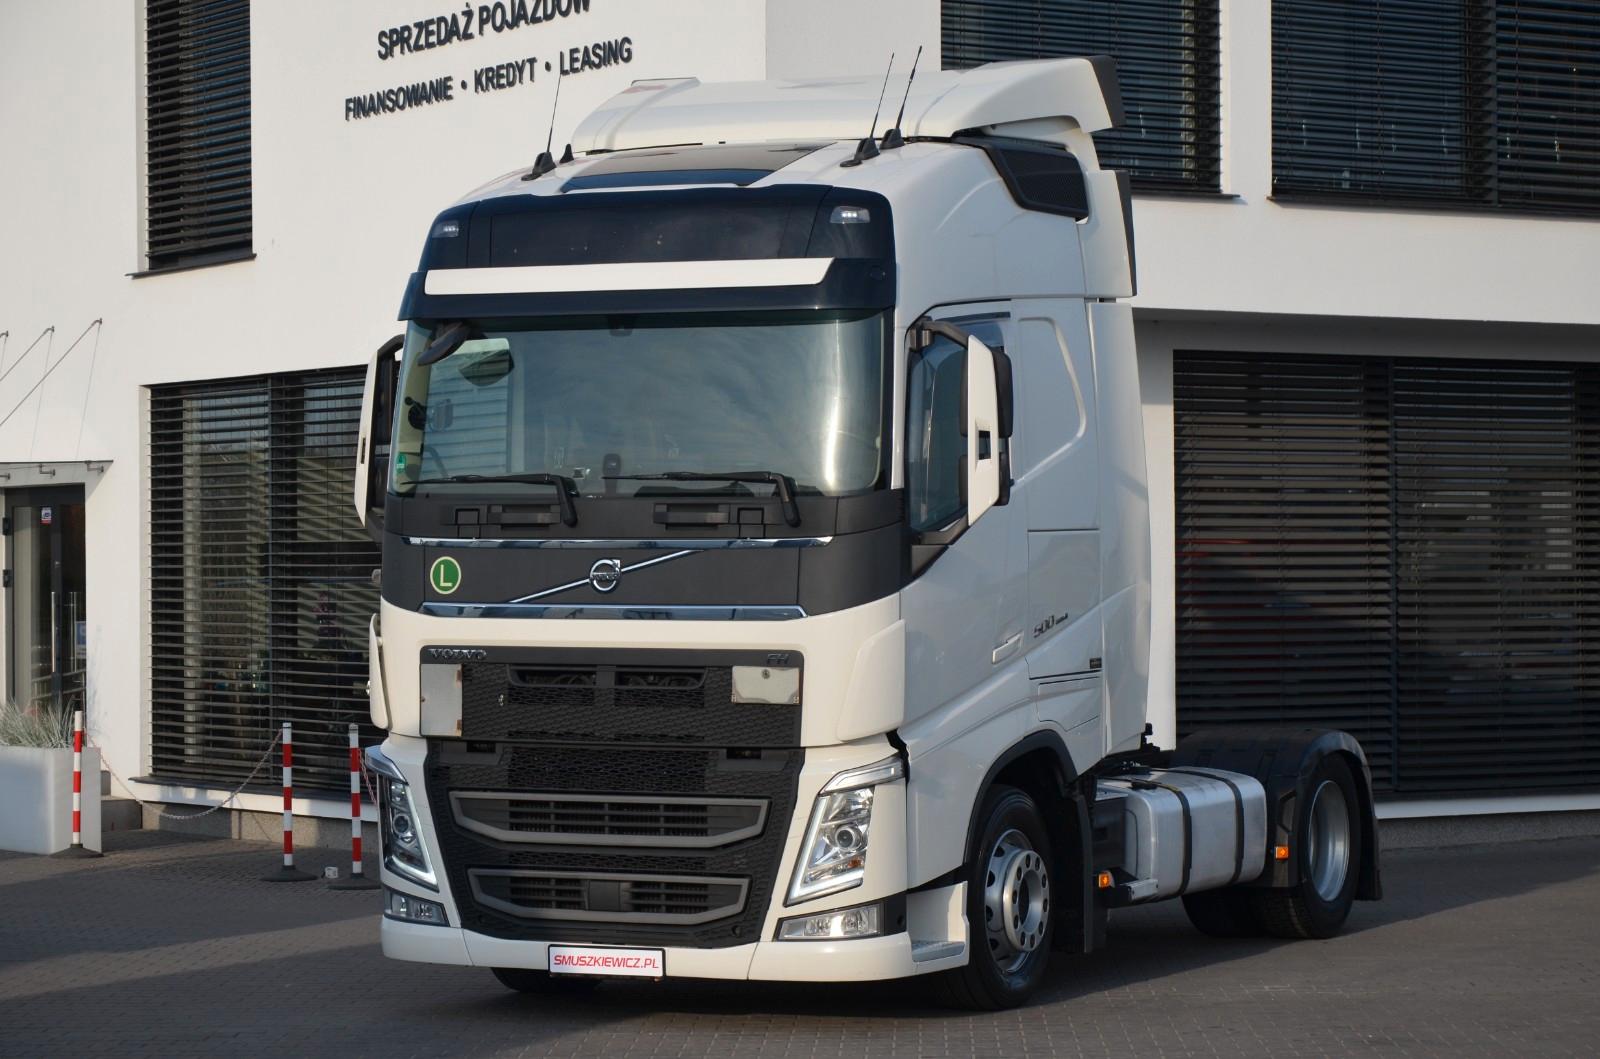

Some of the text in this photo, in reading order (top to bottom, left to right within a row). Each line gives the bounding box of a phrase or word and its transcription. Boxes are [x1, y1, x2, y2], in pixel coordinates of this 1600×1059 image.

[377, 3, 475, 60] SPRZEDAŻ
[345, 36, 633, 120] FINANSOWANIE KREDYT LEASING
[440, 564, 453, 587] L
[553, 954, 660, 969] SMUSZKIEWICZ.PL
